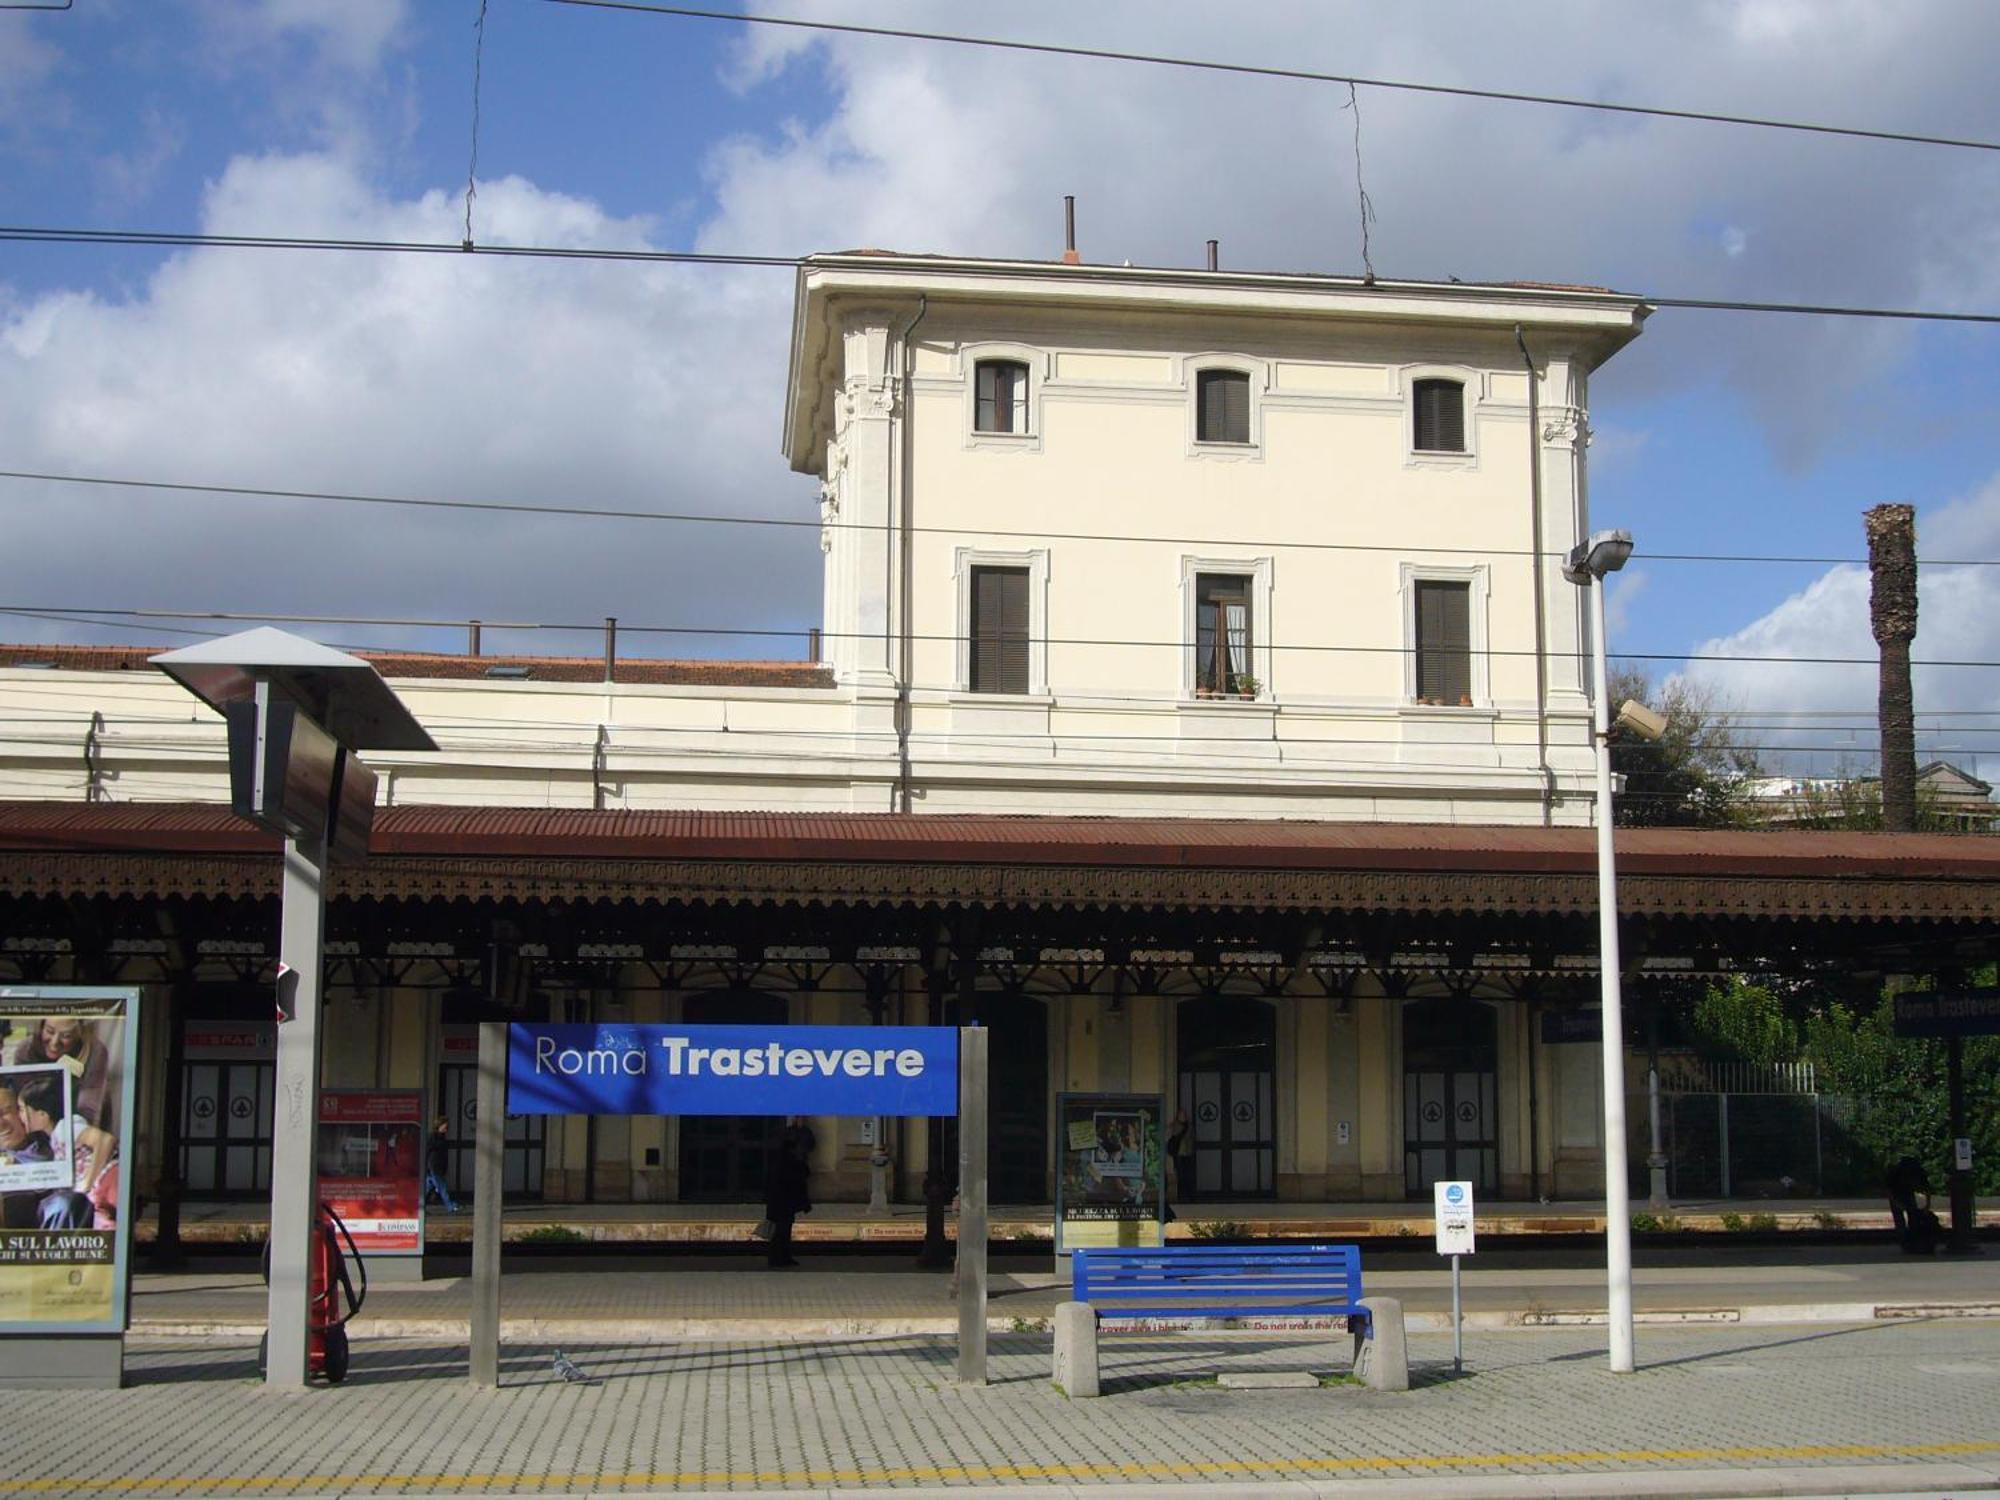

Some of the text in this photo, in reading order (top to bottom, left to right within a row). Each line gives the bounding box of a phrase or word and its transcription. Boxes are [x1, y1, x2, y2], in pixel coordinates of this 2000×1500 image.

[536, 1036, 647, 1075] Roma
[662, 1037, 925, 1077] Trastevere
[8, 1236, 40, 1249] SUL
[45, 1235, 108, 1249] LAVORO.
[34, 1250, 71, 1259] VUOLE
[1254, 1322, 1269, 1330] Do
[1270, 1322, 1286, 1330] not
